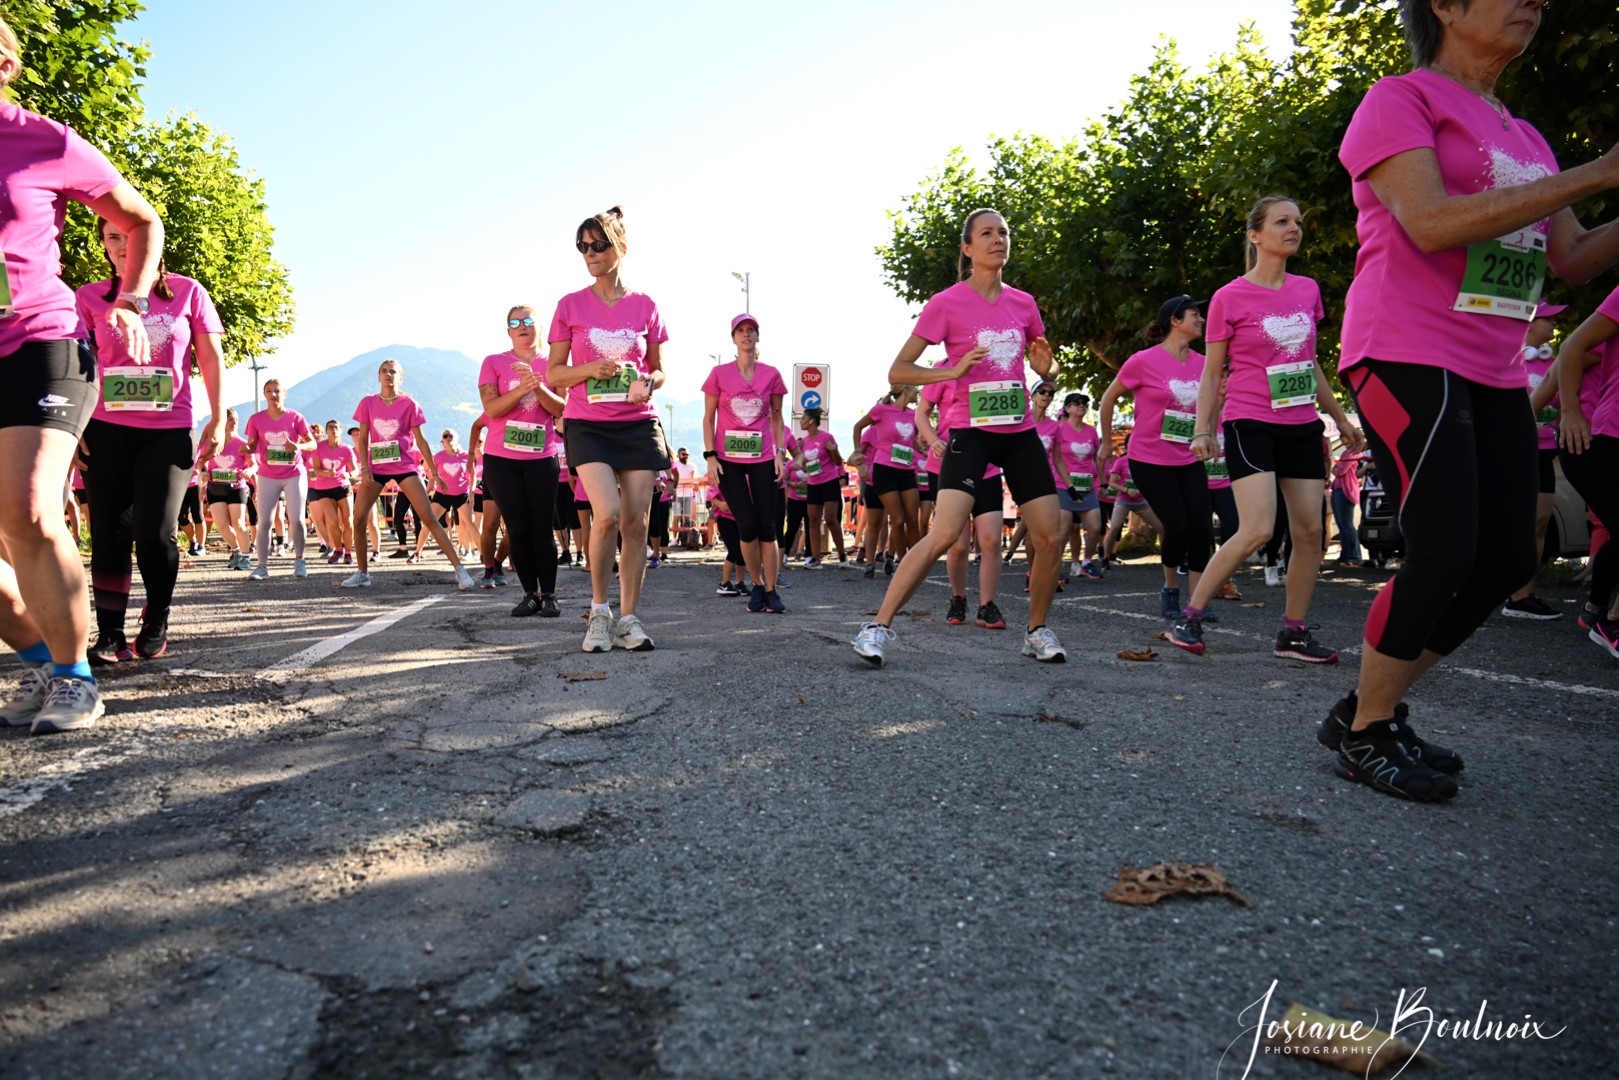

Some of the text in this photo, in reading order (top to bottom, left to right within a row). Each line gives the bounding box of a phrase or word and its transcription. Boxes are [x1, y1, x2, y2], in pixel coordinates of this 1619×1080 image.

[1480, 253, 1537, 290] 2286
[114, 381, 162, 396] 2051
[593, 374, 631, 389] 2173
[1278, 375, 1312, 393] 2287
[978, 395, 1019, 411] 2288
[1168, 420, 1195, 433] 2221
[510, 431, 540, 443] 2001
[730, 440, 756, 449] 2009
[271, 451, 293, 460] 2344
[374, 448, 396, 457] 2257
